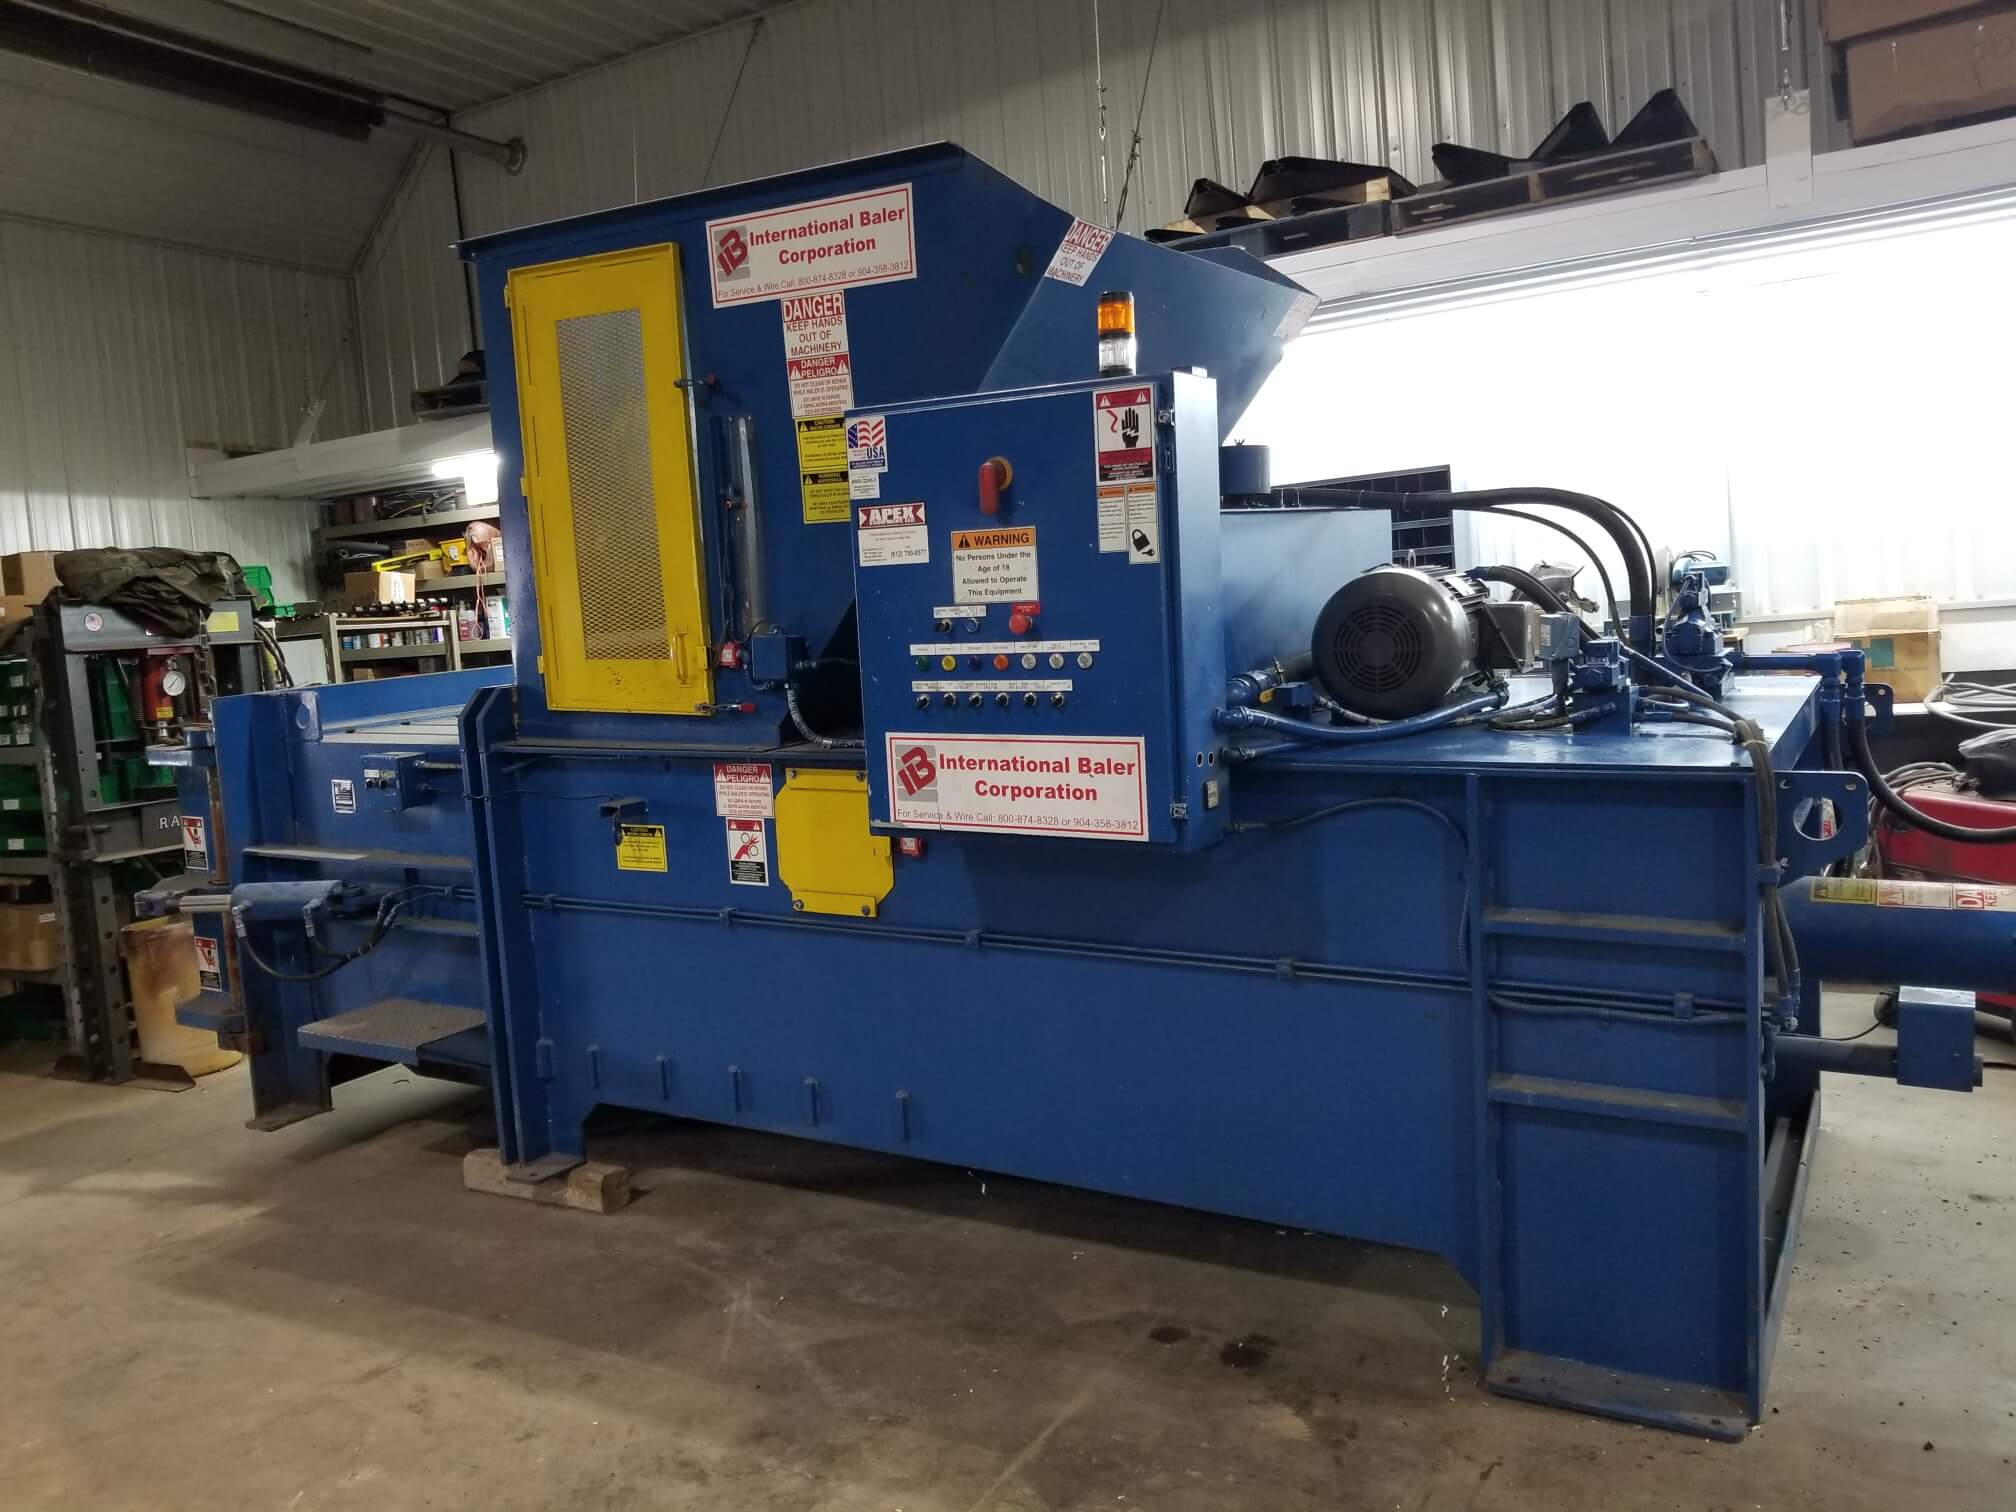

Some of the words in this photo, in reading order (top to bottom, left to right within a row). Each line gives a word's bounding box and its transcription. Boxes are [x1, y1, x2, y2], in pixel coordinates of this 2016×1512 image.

[750, 214, 854, 246] International
[859, 208, 905, 227] Baler
[1067, 222, 1113, 253] DANGER
[779, 236, 876, 264] Corporation
[1060, 257, 1076, 267] OUT
[718, 288, 729, 298] For
[730, 284, 755, 297] Service
[756, 284, 762, 292] &
[763, 280, 779, 291] Wire
[781, 279, 795, 289] Call:
[797, 270, 846, 286] 800-874-8328
[857, 260, 909, 277] 904-358-3812
[783, 293, 843, 321] DANGER
[786, 320, 809, 333] KEEP
[812, 316, 843, 329] HANDS
[799, 332, 817, 343] OUT
[819, 329, 832, 340] OF
[791, 341, 842, 356] MACHINERY
[800, 356, 836, 369] DANGER
[800, 367, 837, 379] PELIGRO
[866, 446, 886, 459] USA
[870, 506, 915, 523] APEX
[974, 533, 1030, 547] WARNING
[996, 552, 1018, 560] Under
[977, 565, 991, 573] Age
[962, 577, 989, 585] Allowed
[999, 576, 1027, 584] Operate
[984, 587, 1022, 596] Equipment
[727, 765, 758, 774] DANGER
[939, 753, 1070, 773] International
[1078, 757, 1136, 776] Baler
[727, 774, 760, 783] PELIGRO
[975, 780, 1098, 801] Corporation
[897, 808, 911, 817] For
[913, 808, 944, 819] Service
[946, 811, 952, 820] &
[954, 811, 974, 821] Wire
[976, 813, 996, 822] Call:
[998, 814, 1059, 826] 800-874-8328
[1073, 817, 1138, 830] 904-358-3812
